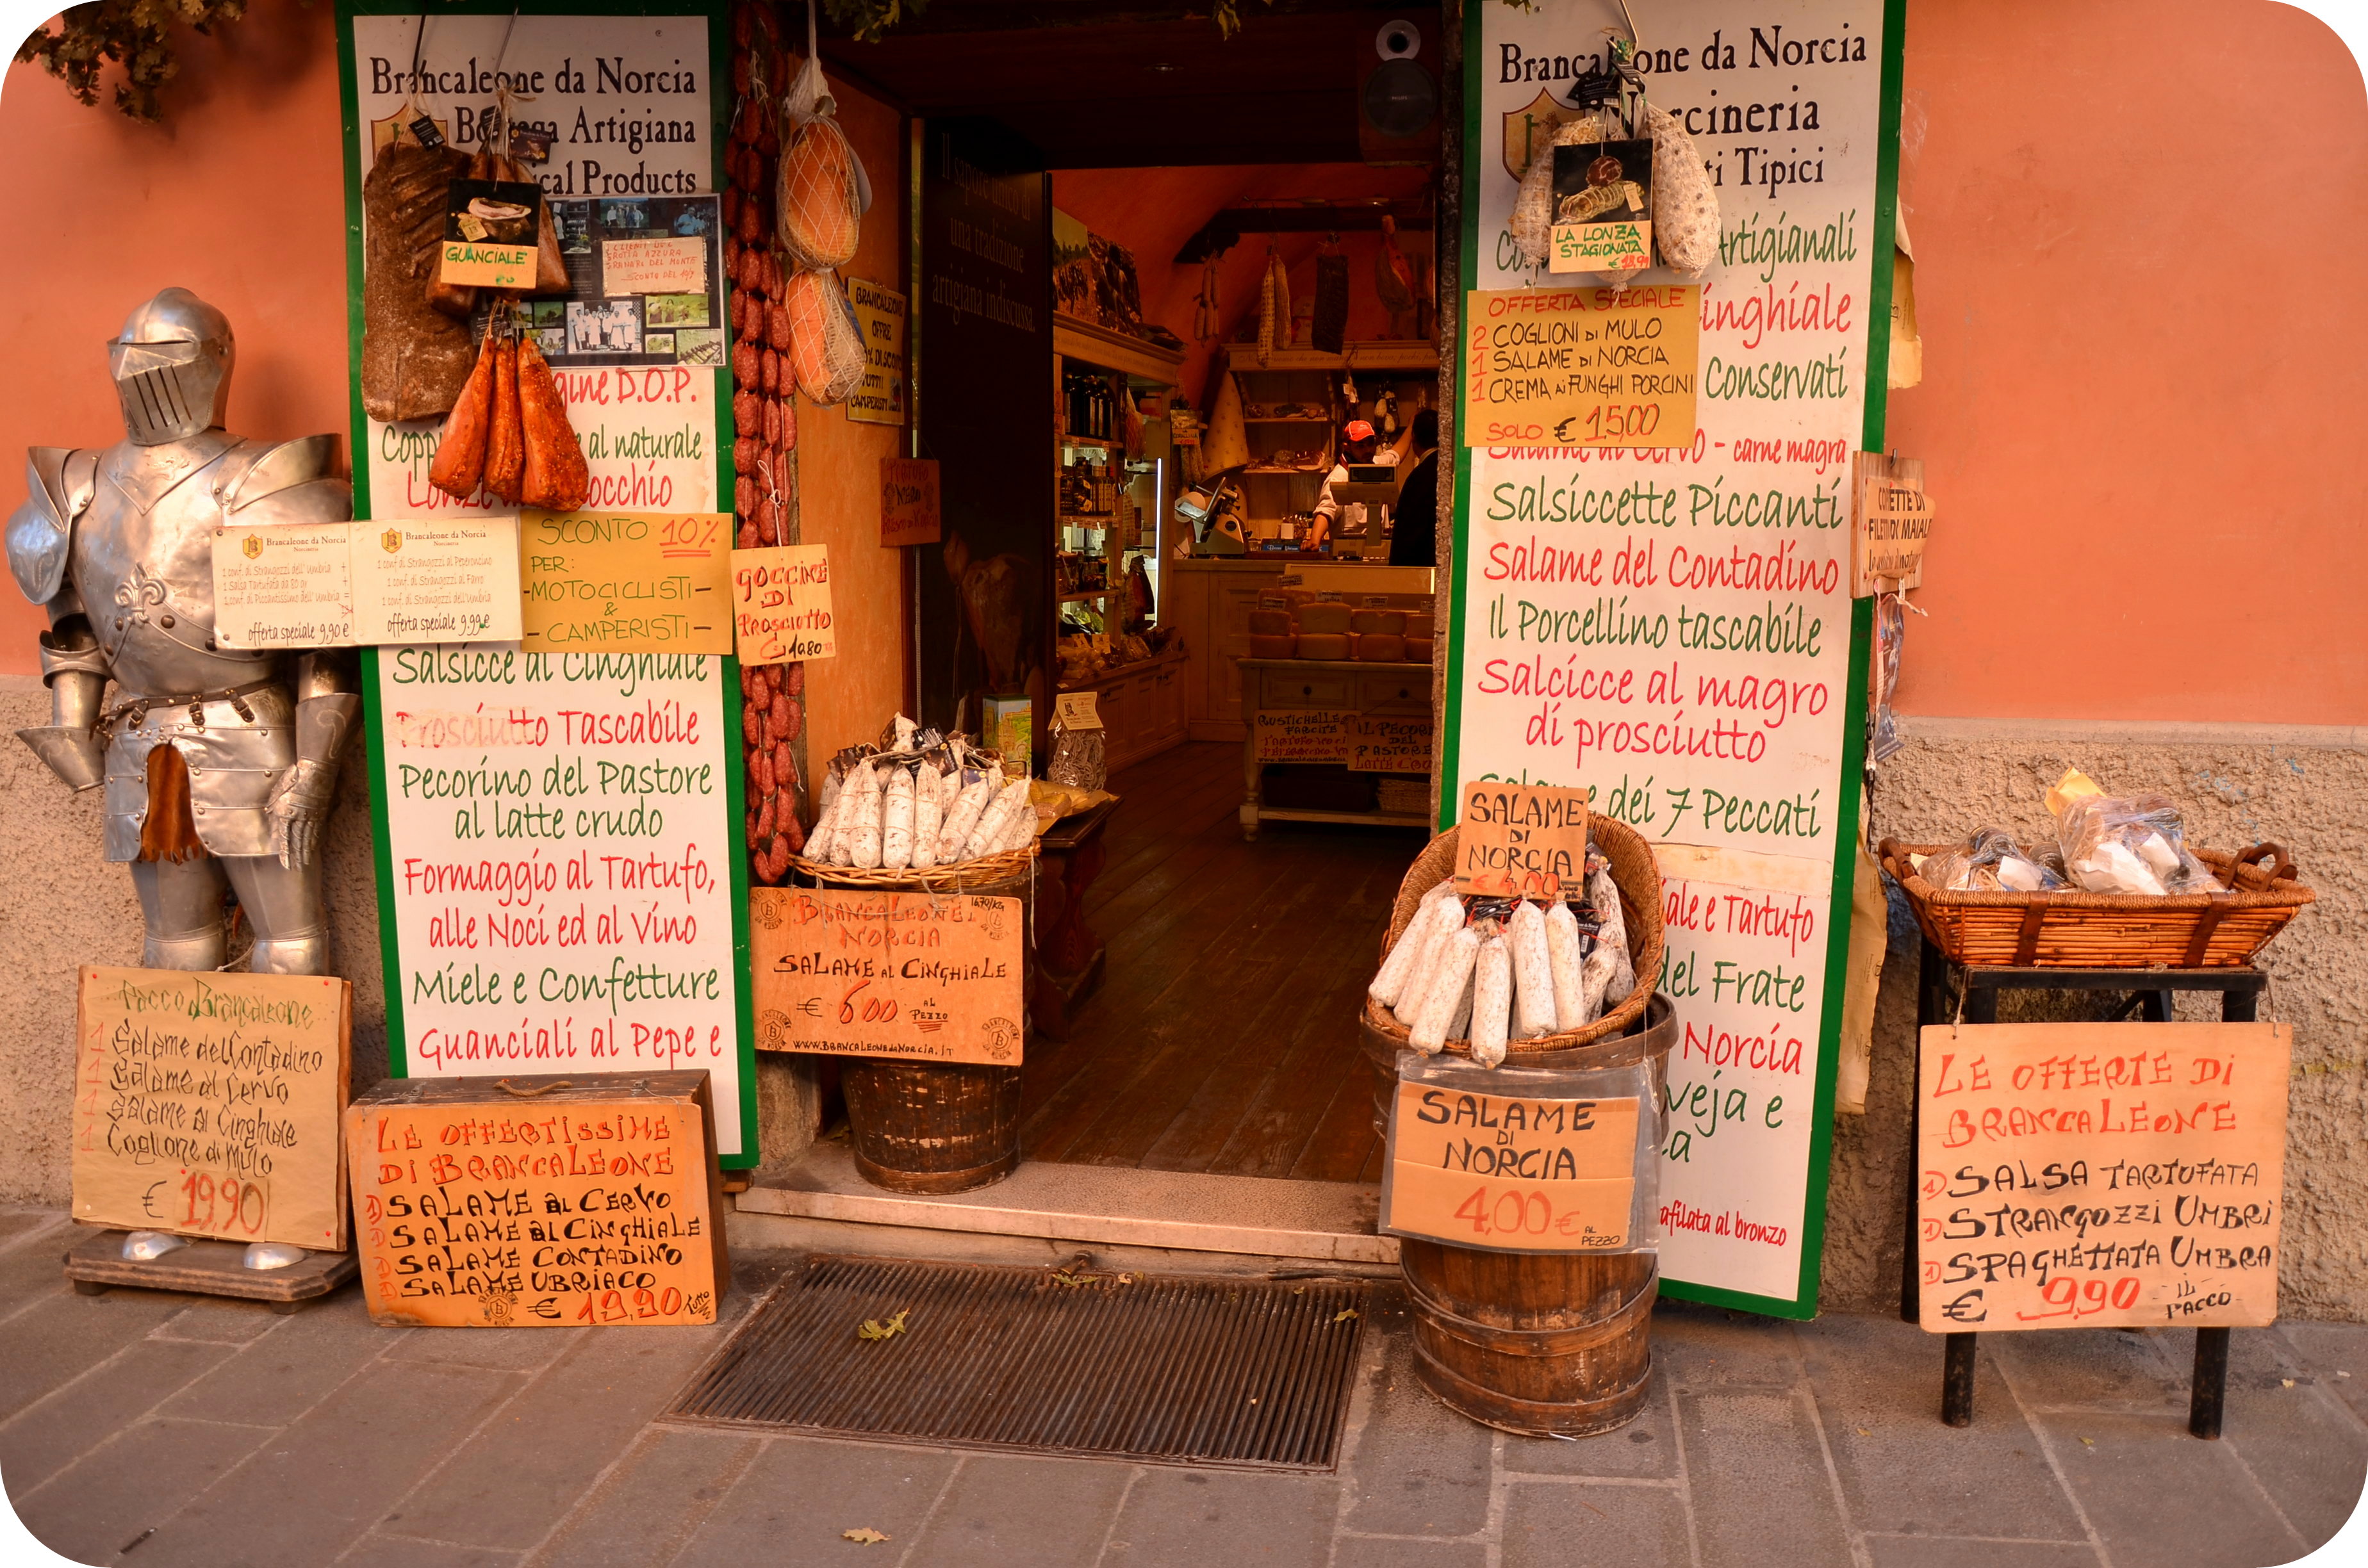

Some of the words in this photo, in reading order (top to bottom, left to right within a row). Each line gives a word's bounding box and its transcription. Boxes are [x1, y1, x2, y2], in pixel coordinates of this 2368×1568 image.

[1701, 29, 1736, 70] da
[1750, 23, 1868, 69] Norcia
[371, 56, 545, 95] Brancaleone
[554, 58, 588, 94] da
[596, 58, 696, 94] Norcia
[570, 106, 696, 154] Artigiana
[583, 162, 696, 194] Products
[1735, 147, 1824, 198] Tipici
[1556, 227, 1575, 243] LA
[1583, 224, 1641, 241] LONZA
[1561, 240, 1645, 258] STAGIONATA
[445, 245, 527, 264] GUANCIALE
[1488, 293, 1586, 318] OFFERTA
[1594, 288, 1686, 311] SPECIALE
[872, 320, 891, 341] OFFRE
[1493, 322, 1579, 348] COGLIONI
[1606, 317, 1662, 341] MULO
[1493, 347, 1573, 372] SALAME
[1597, 344, 1669, 368] NORCIA
[1706, 347, 1848, 400] Conservati
[616, 368, 697, 404] D.O.P.
[589, 425, 607, 460] al
[616, 423, 702, 460] naturale
[1486, 423, 1543, 441] SOLO
[1554, 416, 1576, 442] €
[1734, 438, 1782, 465] carne
[1786, 439, 1846, 475] magra
[1487, 473, 1677, 527] Salsiccette
[1688, 475, 1843, 529] Piccanti
[267, 537, 308, 546] Brancaleone
[406, 532, 448, 540] Brancaleone
[538, 518, 648, 545] SCONTO
[660, 518, 719, 547] 10%
[530, 555, 575, 573] PER:
[1484, 535, 1603, 587] Salame
[1613, 535, 1658, 587] del
[1668, 539, 1838, 594] Contadino
[388, 612, 418, 638] offerta
[420, 612, 456, 638] speciale
[604, 601, 618, 616] &
[1490, 593, 1508, 639] Il
[1518, 596, 1668, 649] Porcellino
[1678, 601, 1821, 658] tascabile
[249, 622, 278, 646] offerta
[281, 621, 315, 646] speciale
[318, 623, 341, 645] 9,90
[343, 623, 350, 638] €
[393, 642, 514, 683] Salsicce
[563, 653, 709, 696] Cinghiale
[1478, 653, 1633, 703] Salcicce
[1647, 662, 1684, 705] al
[1698, 675, 1828, 728] magro
[557, 699, 700, 746] Tascabile
[1526, 701, 1563, 746] di
[1574, 710, 1766, 769] prosciutto
[399, 756, 532, 799] Pecorino
[543, 755, 589, 796] del
[597, 759, 713, 796] Pastore
[456, 801, 481, 840] al
[495, 799, 565, 840] latte
[577, 796, 663, 838] crudo
[1470, 792, 1584, 829] SALAME
[1608, 774, 1656, 826] dei
[1662, 788, 1693, 837] 7
[1703, 788, 1821, 838] Peccati
[1509, 829, 1531, 844] DI
[404, 849, 557, 906] Formaggio
[566, 850, 593, 890] al
[600, 843, 715, 904] Tartufo,
[1468, 845, 1573, 877] NORCIA
[430, 908, 479, 949] alle
[488, 904, 549, 948] Noci
[557, 904, 587, 945] ed
[597, 904, 623, 944] al
[630, 902, 697, 945] Vino
[1723, 895, 1813, 958] Tartufo
[413, 963, 502, 1006] Miele
[513, 972, 529, 1004] e
[539, 956, 719, 1017] Confetture
[774, 952, 875, 979] SALAME
[881, 965, 895, 979] AL
[900, 958, 1007, 986] CINGHIALE
[1713, 961, 1805, 1012] Frate
[909, 1009, 948, 1020] PEZZO
[923, 997, 935, 1007] AL
[419, 1016, 577, 1070] Guanciali
[591, 1018, 618, 1058] al
[631, 1022, 696, 1069] Pepe
[710, 1025, 722, 1056] e
[1684, 1022, 1802, 1074] Norcia
[110, 1056, 193, 1094] Salame
[199, 1070, 219, 1099] al
[1933, 1054, 1992, 1098] LE
[2012, 1050, 2173, 1090] OFFERTE
[1417, 1090, 1597, 1134] SALAME
[1942, 1098, 2236, 1148] BRANCALEONE
[1497, 1129, 1514, 1147] DI
[1443, 1138, 1576, 1180] NORCIA
[1947, 1159, 2089, 1198] SALSA
[2099, 1157, 2259, 1190] TARTUFATA
[1454, 1186, 1552, 1237] 4,00
[1555, 1210, 1581, 1236] €
[1715, 1211, 1731, 1236] al
[1735, 1211, 1786, 1246] bronzo
[1582, 1234, 1620, 1246] PEZZO
[2170, 1236, 2272, 1270] UMBRA
[401, 1271, 524, 1298] SALAME
[531, 1270, 656, 1294] UBRIACO
[2165, 1292, 2232, 1319] PACCO
